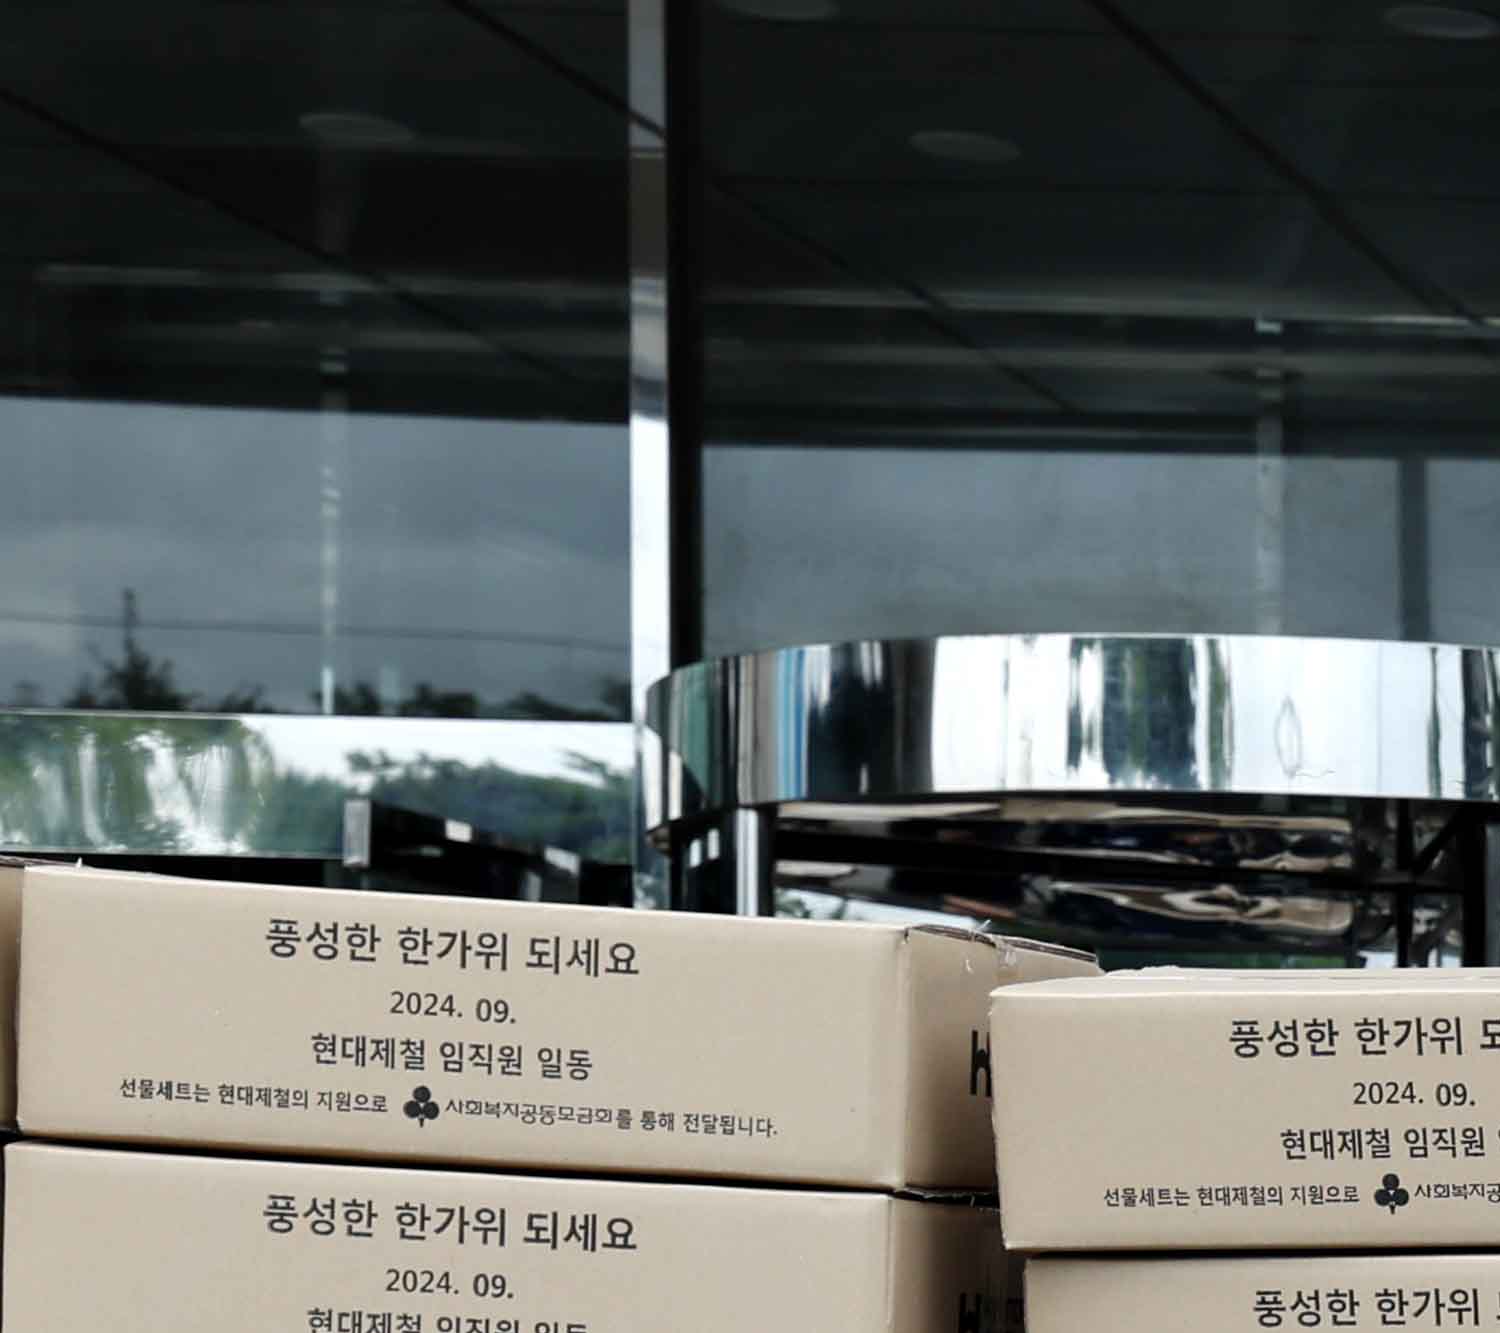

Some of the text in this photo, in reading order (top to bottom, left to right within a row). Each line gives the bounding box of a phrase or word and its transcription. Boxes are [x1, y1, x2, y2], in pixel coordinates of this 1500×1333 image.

[265, 918, 640, 978] 풍성한 한가위 되세요
[389, 990, 516, 1024] 2024. 09.
[311, 1032, 593, 1081] 현대제철 임직원 일동
[119, 1078, 211, 1103] 선물세트는
[217, 1083, 309, 1110] 현대제철의
[317, 1091, 388, 1113] 지원으로
[639, 1110, 675, 1132] 통해
[683, 1113, 777, 1138] 전달됩니다.
